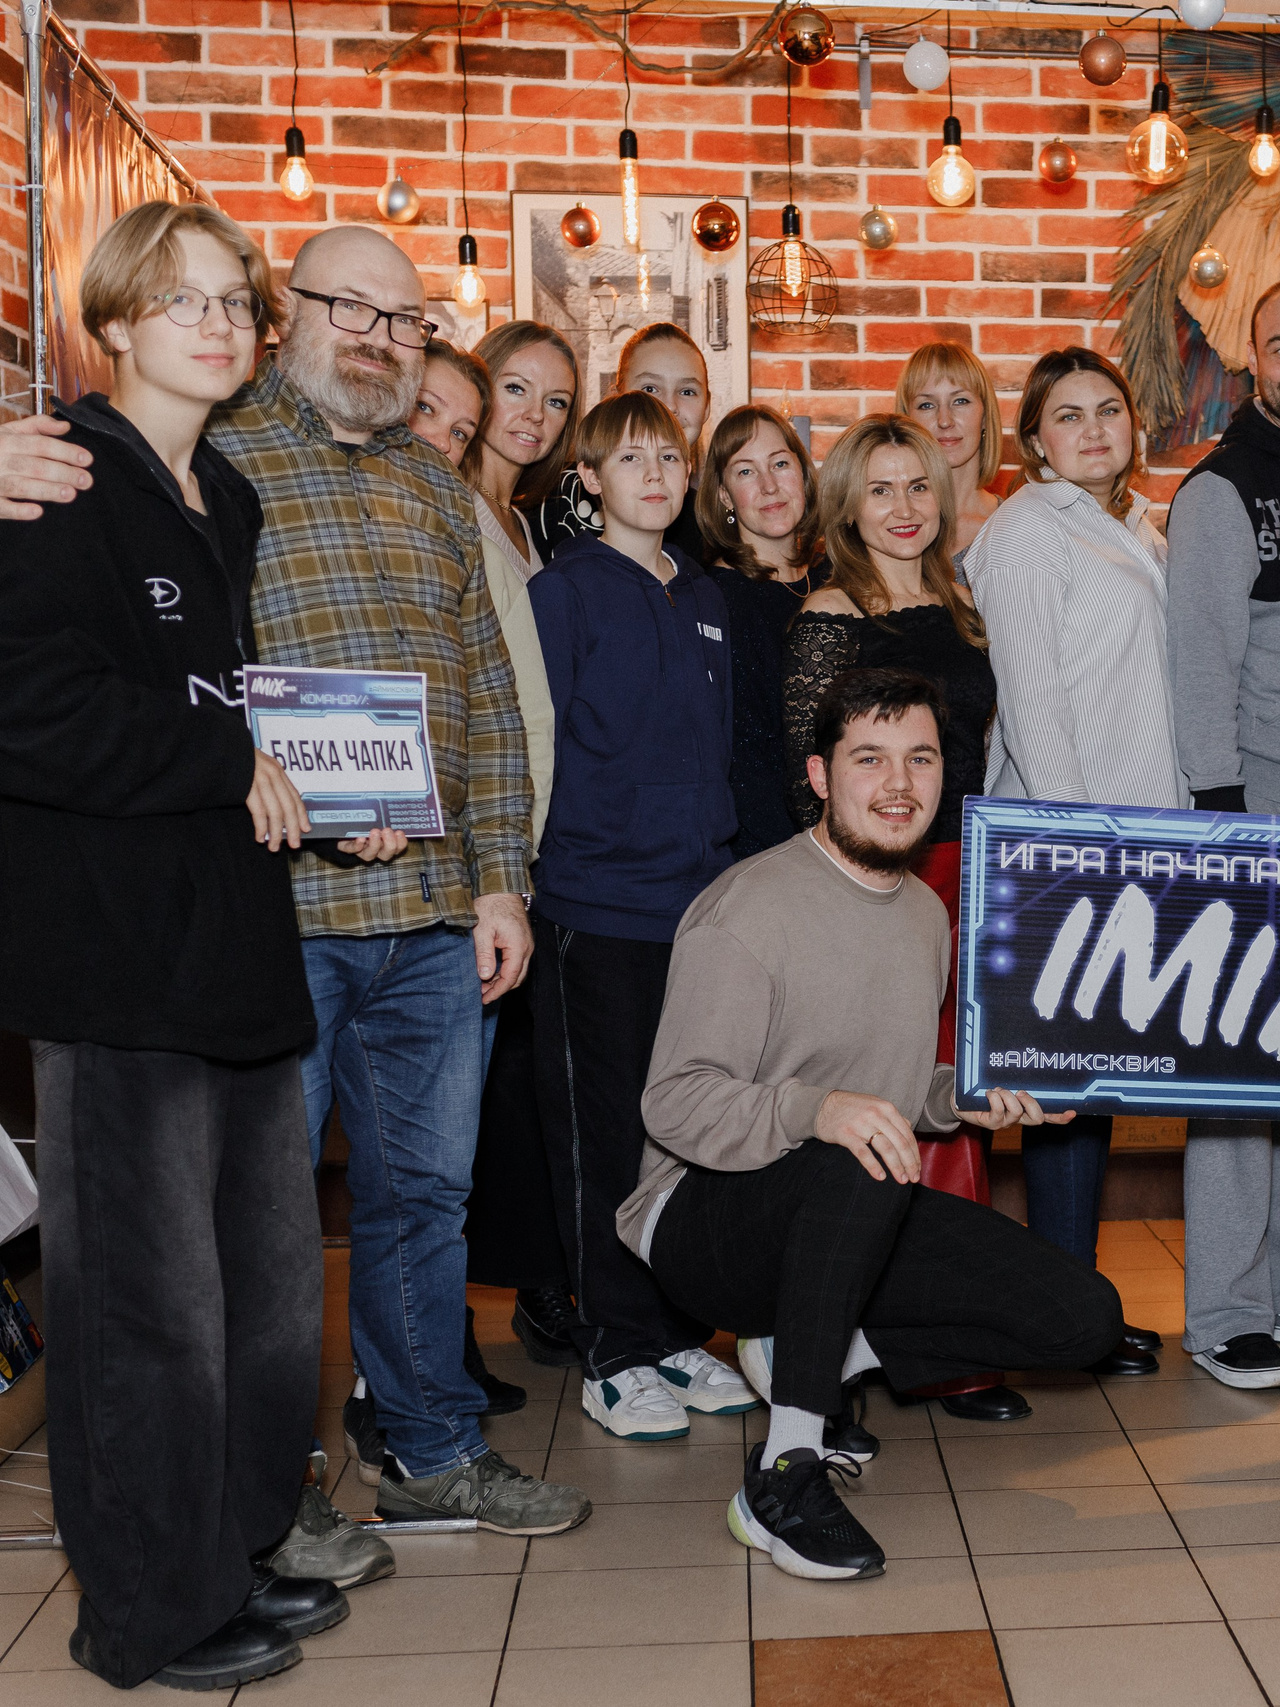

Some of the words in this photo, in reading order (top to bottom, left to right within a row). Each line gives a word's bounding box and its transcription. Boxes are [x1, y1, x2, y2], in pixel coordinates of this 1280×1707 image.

[270, 740, 343, 771] БАБКА
[344, 740, 413, 771] ЧАПКА
[1000, 842, 1106, 875] ИГРА
[989, 1047, 1177, 1074] #АЙМИКСКВИЗ
